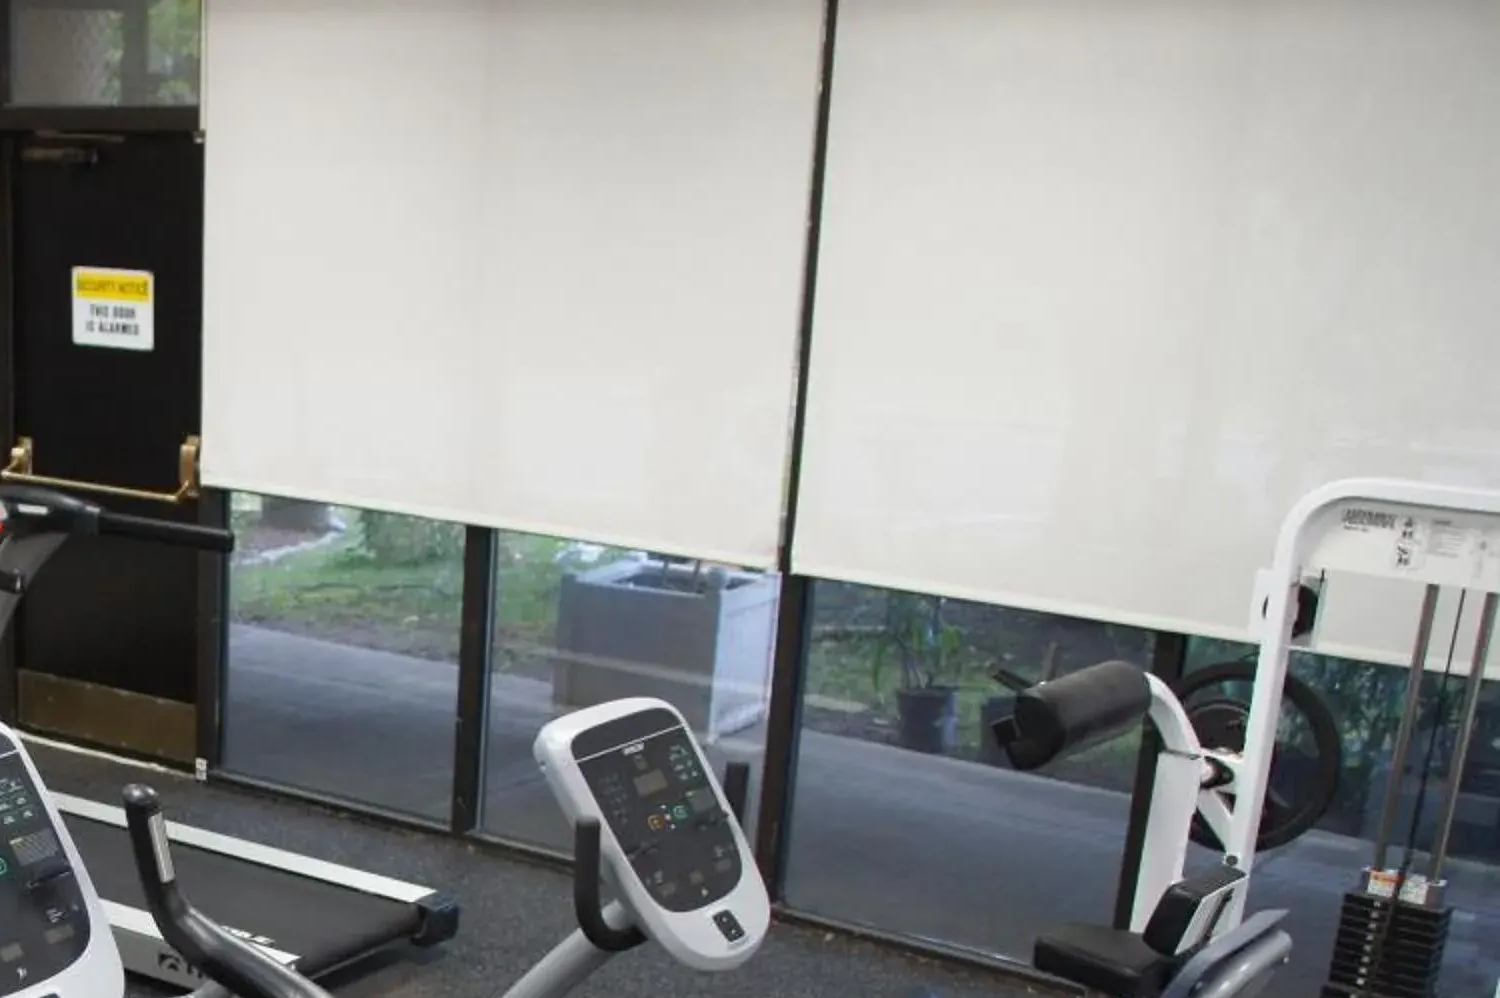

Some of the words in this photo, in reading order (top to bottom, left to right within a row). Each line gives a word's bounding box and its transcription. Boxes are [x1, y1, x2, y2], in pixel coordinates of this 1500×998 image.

[90, 303, 109, 317] THIS
[113, 304, 135, 319] DOOR
[86, 320, 94, 332] IS
[98, 321, 139, 336] ALARMED
